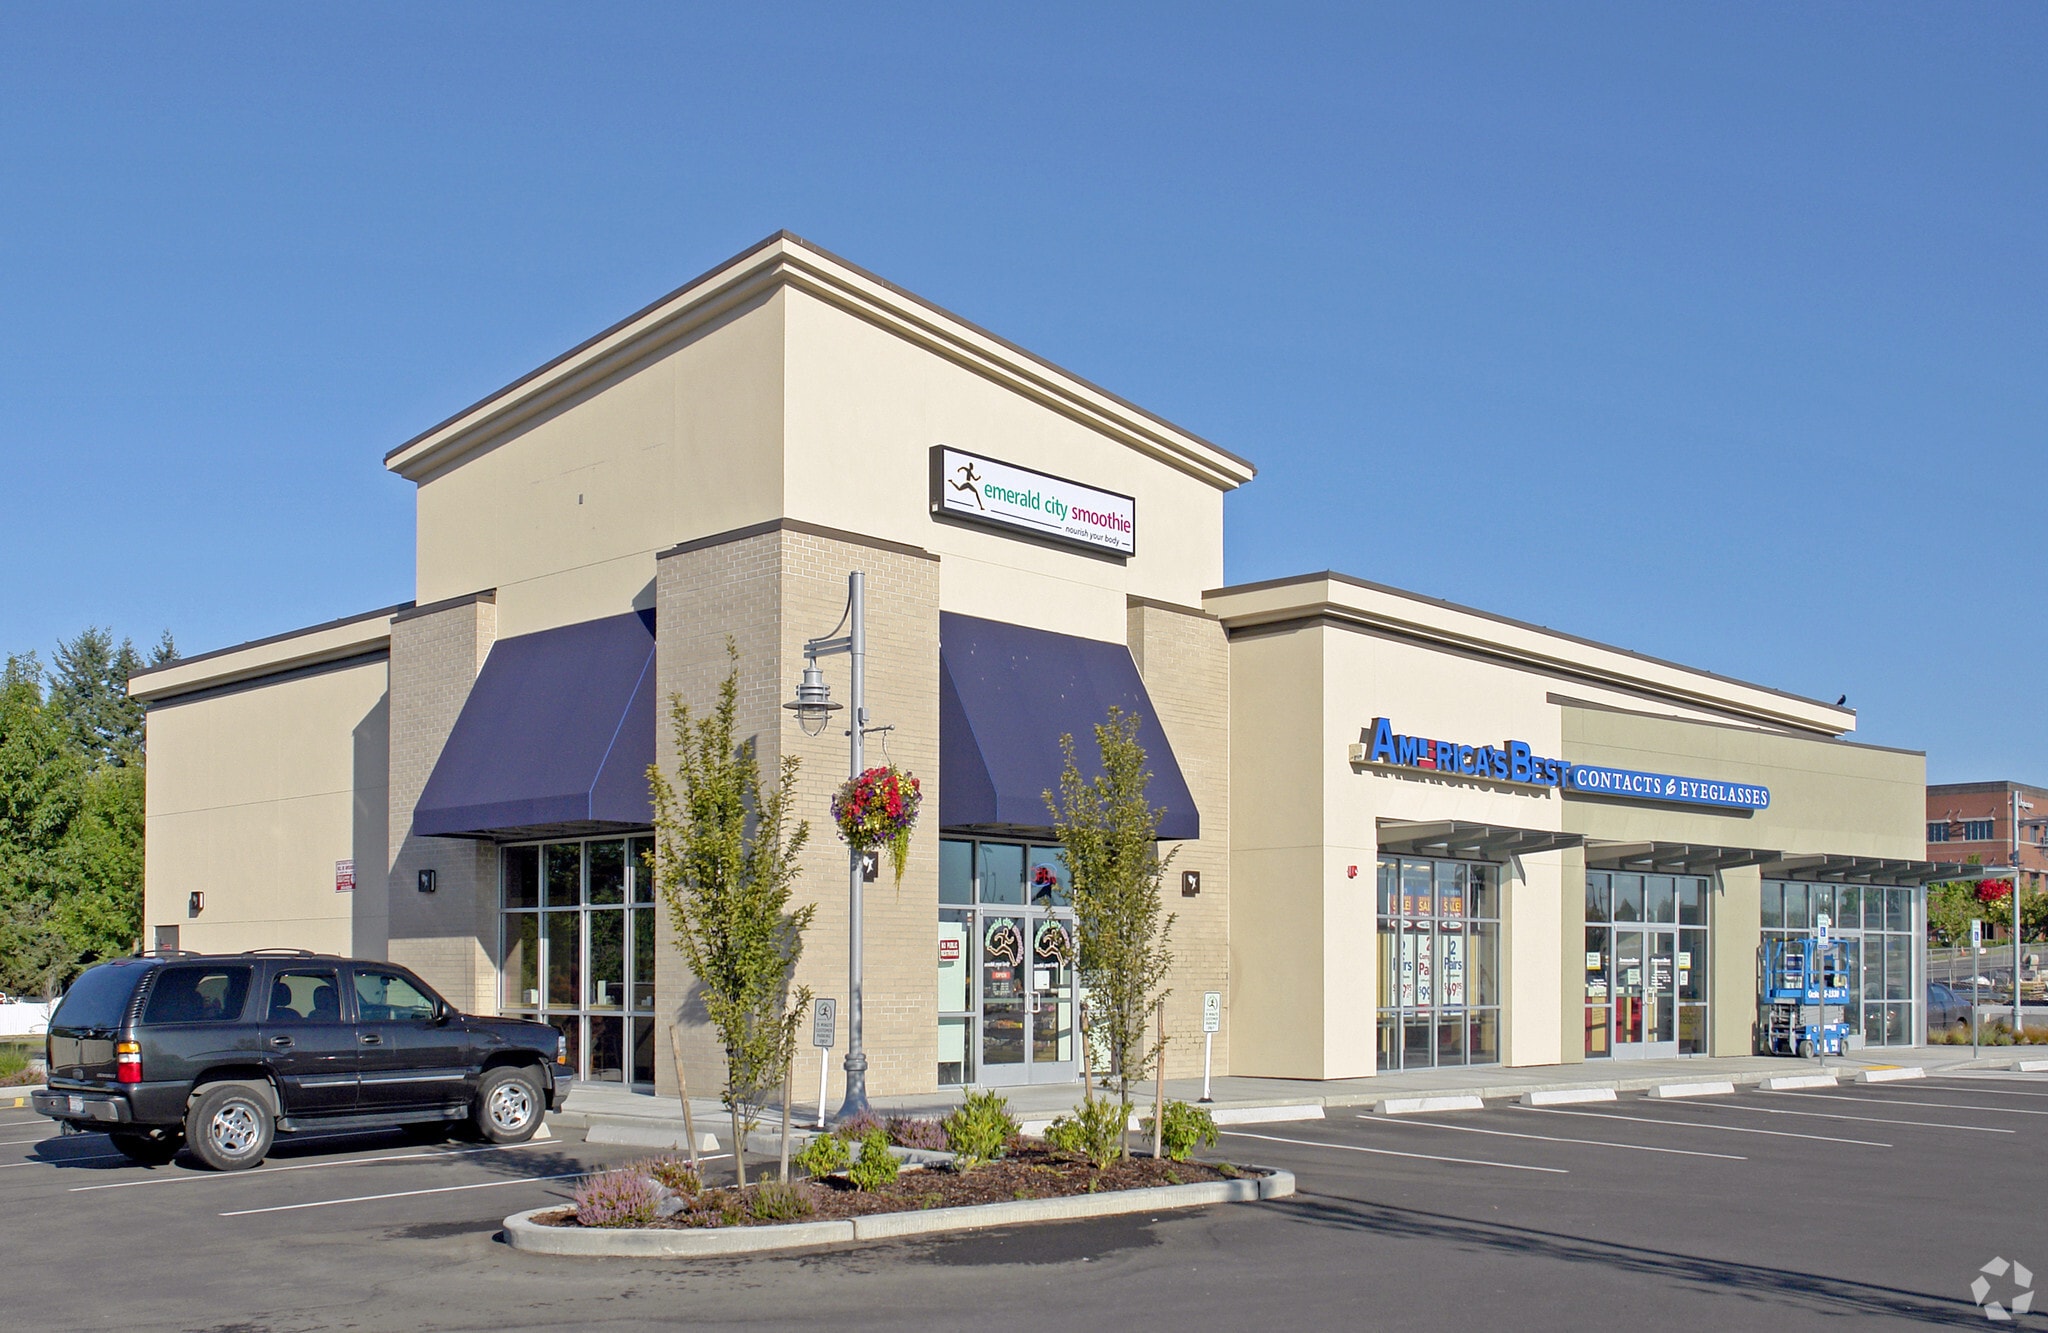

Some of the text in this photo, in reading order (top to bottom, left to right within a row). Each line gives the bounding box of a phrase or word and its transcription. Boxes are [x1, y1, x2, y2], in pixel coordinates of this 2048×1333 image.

[984, 483, 1131, 533] emerald city smoothie
[1065, 526, 1120, 546] nourish your body
[1505, 740, 1571, 788] BEST
[1577, 769, 1661, 794] CONTACTS
[1665, 778, 1676, 796] &
[1680, 781, 1768, 806] EYEGLASSES
[1450, 940, 1457, 955] 2
